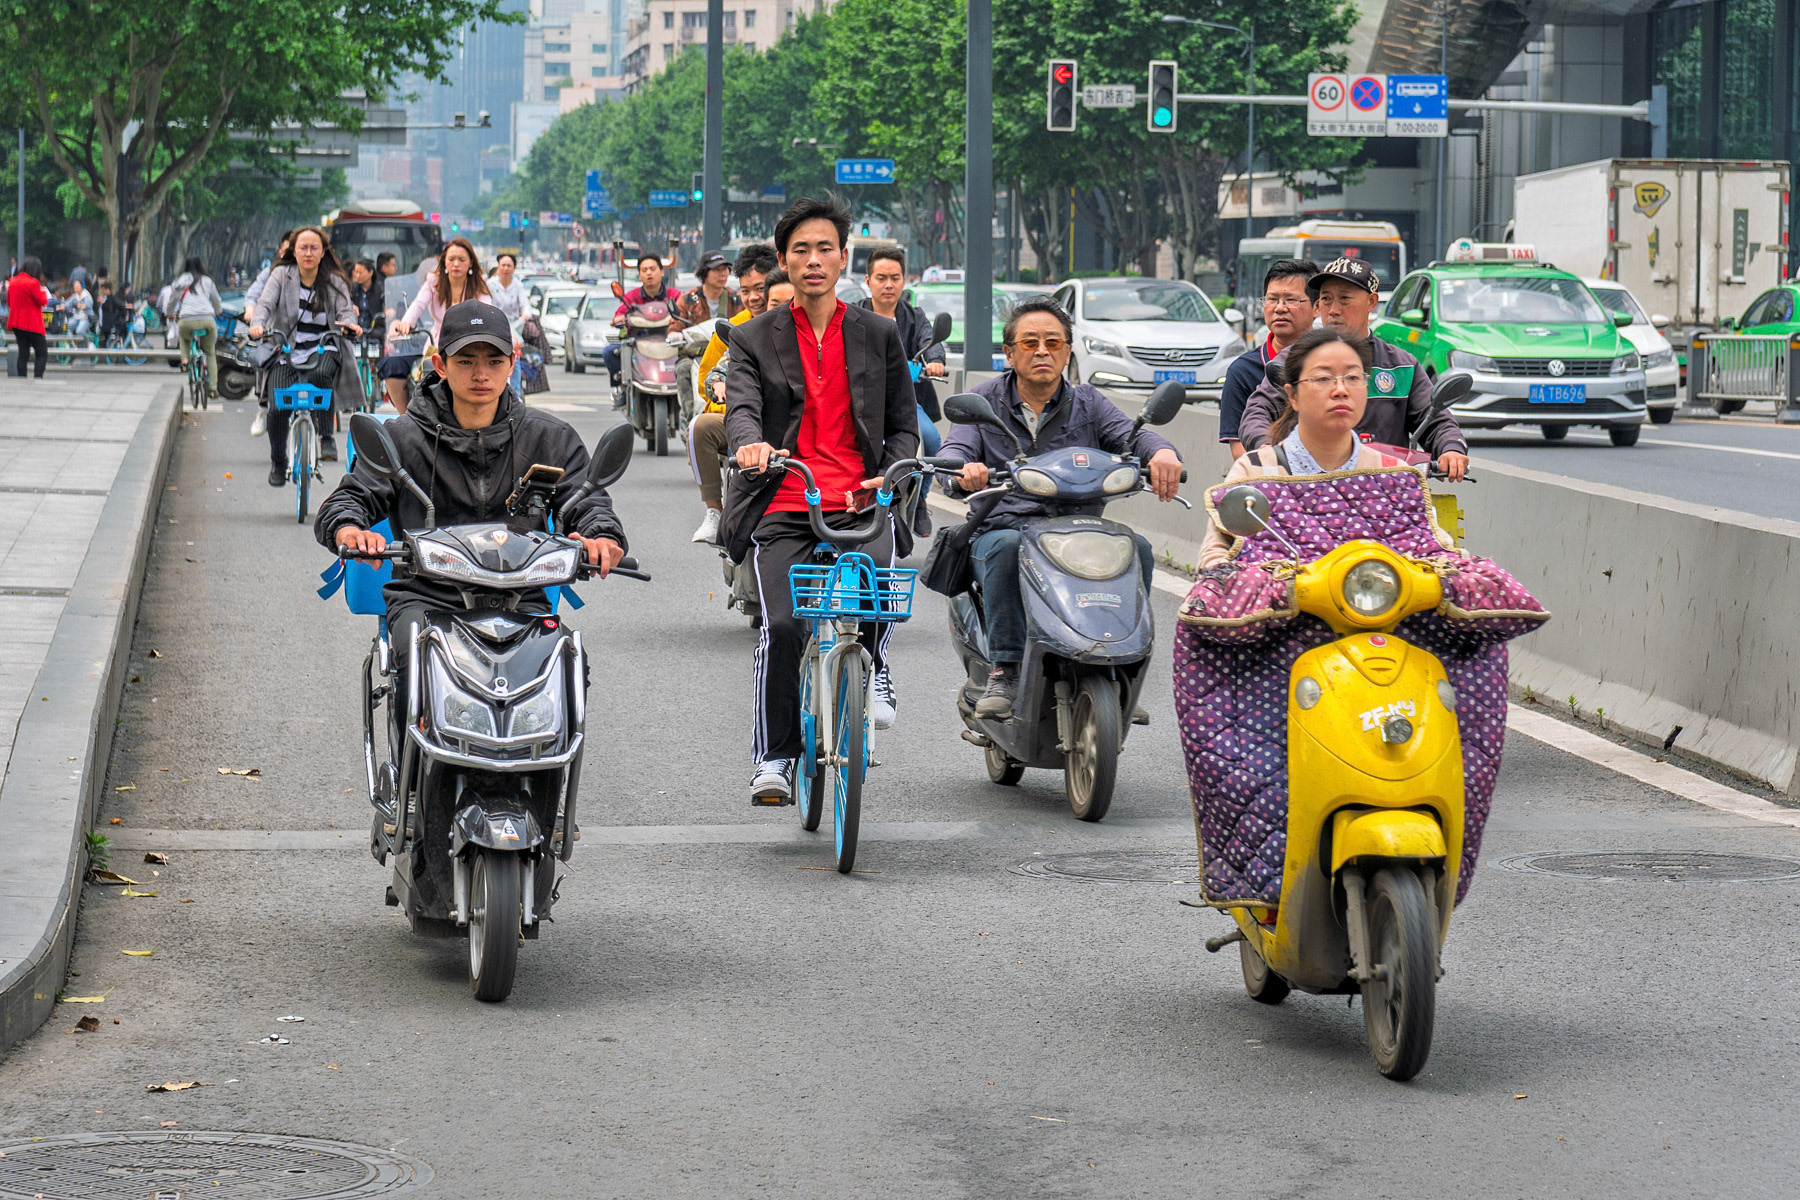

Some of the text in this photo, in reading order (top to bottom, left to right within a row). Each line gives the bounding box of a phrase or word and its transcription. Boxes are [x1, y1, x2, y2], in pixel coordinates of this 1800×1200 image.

[1318, 86, 1338, 101] 60
[1511, 248, 1534, 259] TAXI
[1549, 386, 1584, 400] TB696
